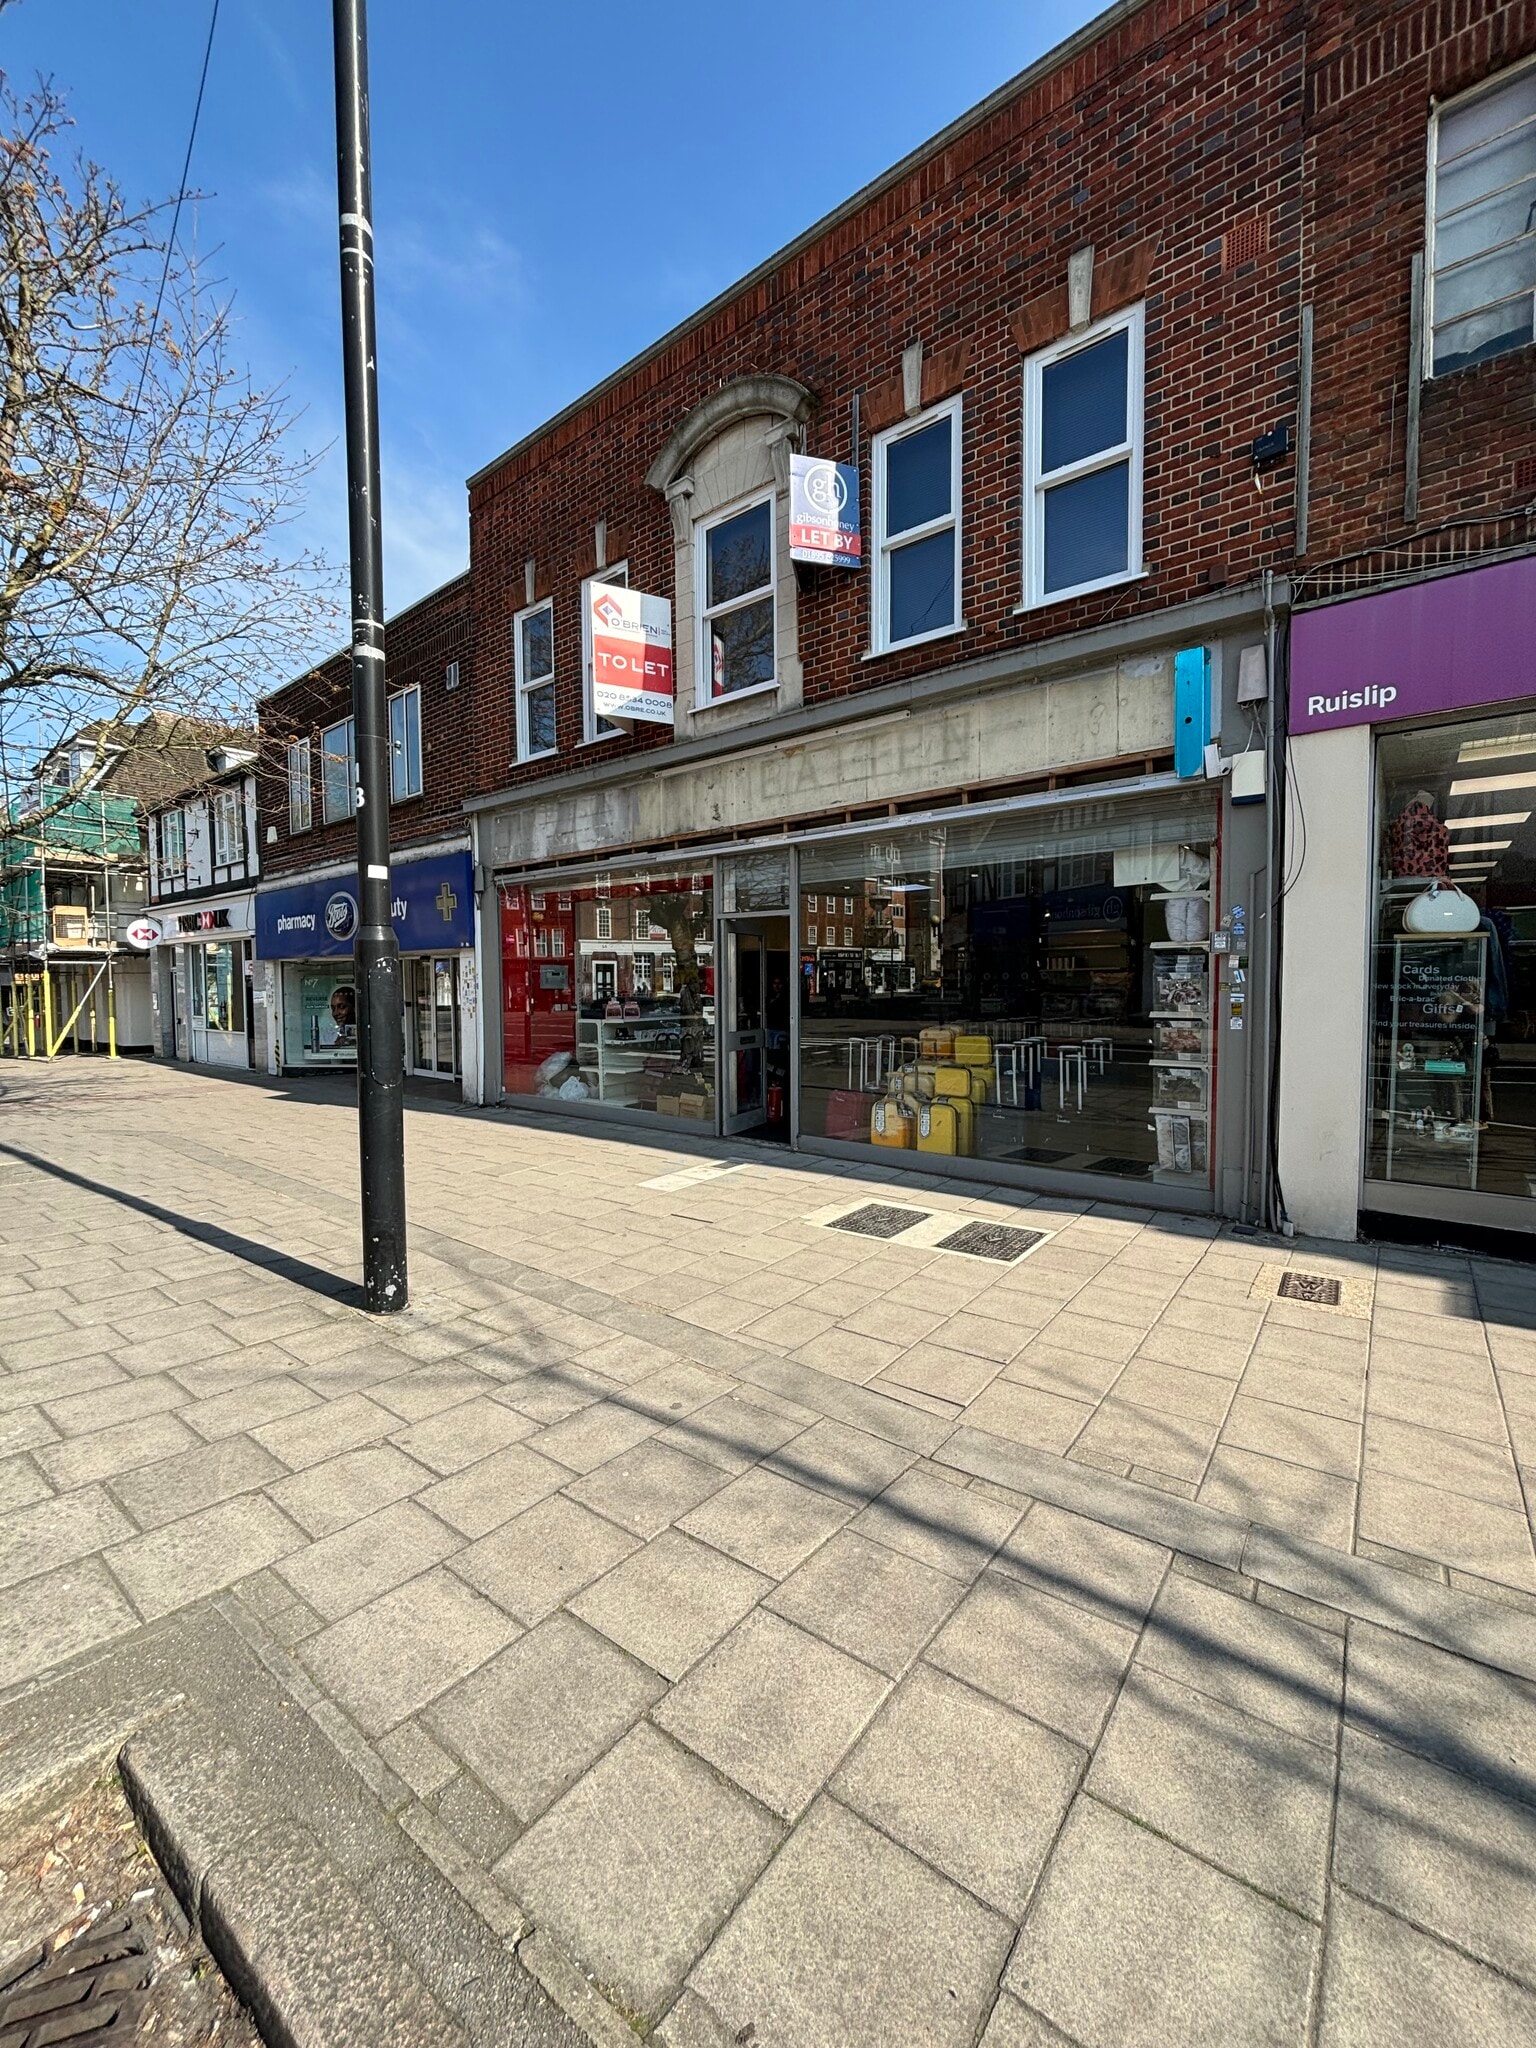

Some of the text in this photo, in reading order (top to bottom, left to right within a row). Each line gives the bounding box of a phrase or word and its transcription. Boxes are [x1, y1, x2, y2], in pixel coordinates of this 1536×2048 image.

[801, 528, 853, 550] LET BY
[611, 618, 658, 635] O'BRIEN
[597, 652, 669, 677] TO LET
[596, 690, 617, 700] 020
[644, 698, 673, 709] 0008
[1308, 684, 1397, 716] Ruislip
[212, 909, 231, 928] UK
[277, 913, 316, 934] pharmacy
[328, 902, 348, 928] Boots
[1402, 964, 1440, 975] Cards
[1390, 982, 1412, 990] stock
[1422, 983, 1460, 991] everyday
[1389, 995, 1435, 1003] Bric-a-brac
[1422, 1003, 1456, 1015] Gifts
[1408, 1021, 1448, 1029] treasures
[1449, 1022, 1476, 1030] inside
